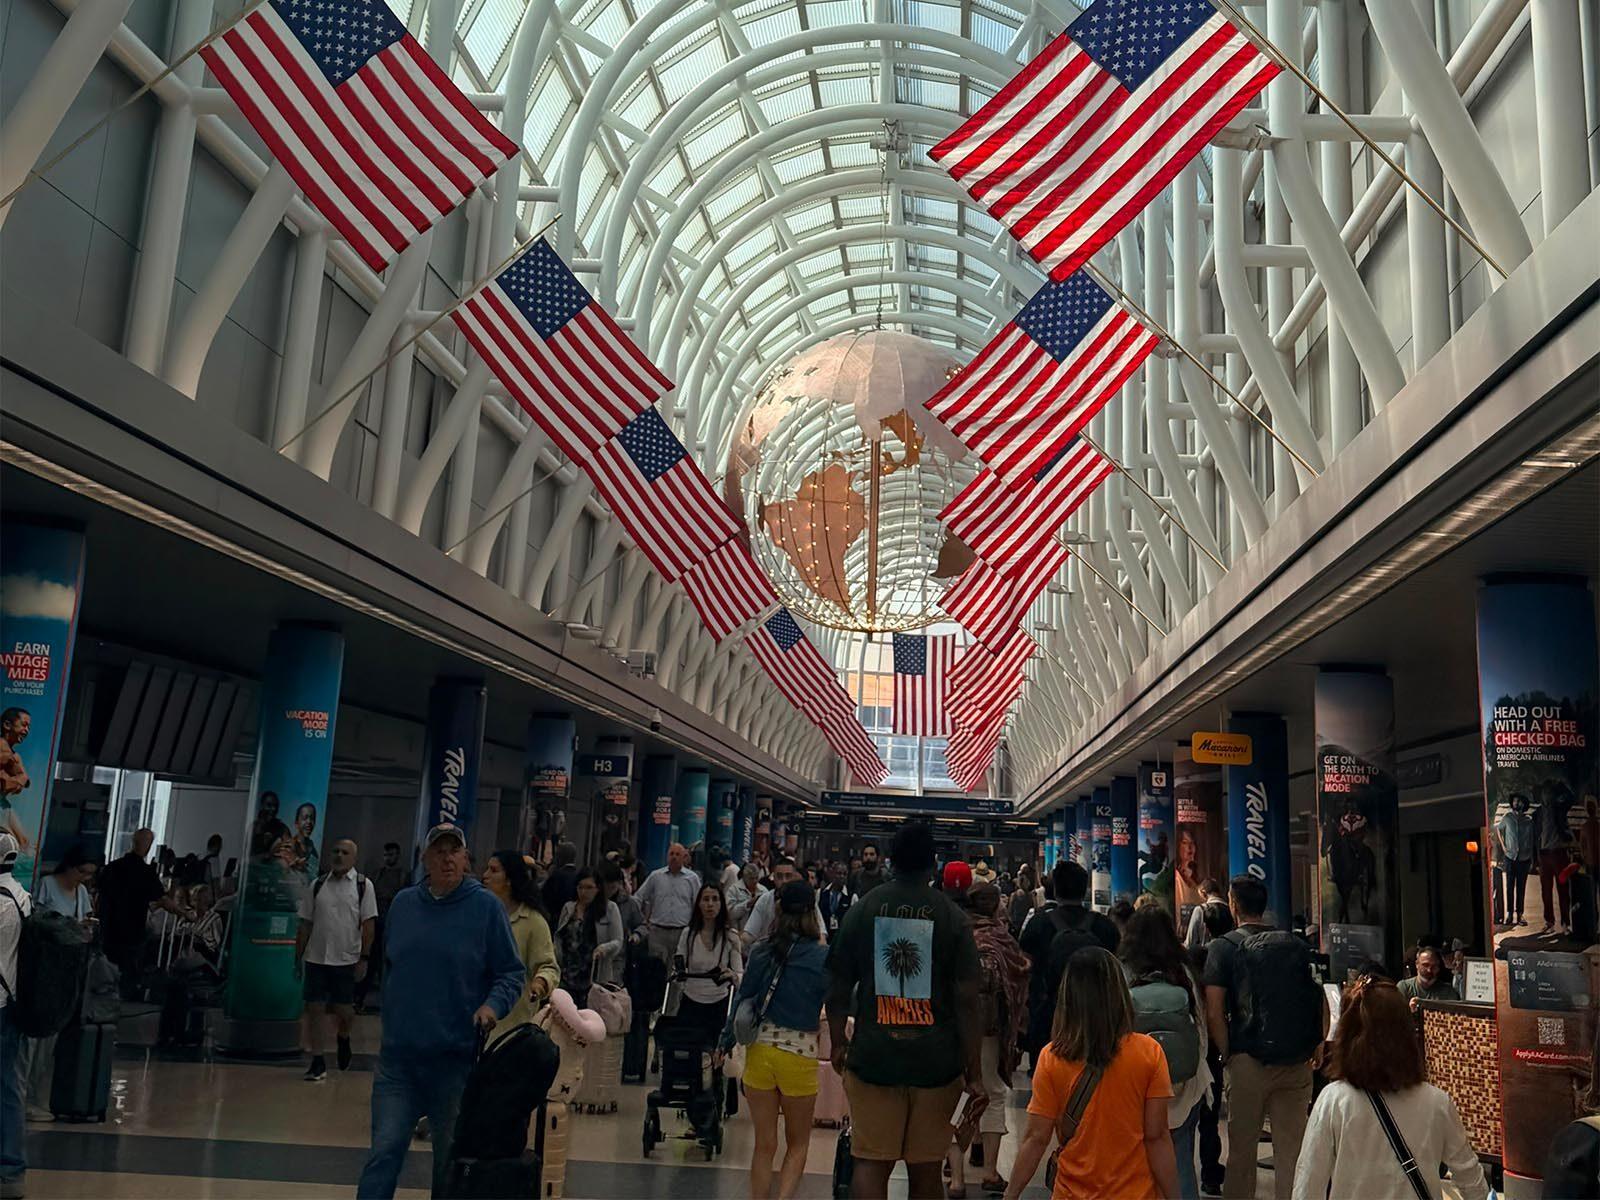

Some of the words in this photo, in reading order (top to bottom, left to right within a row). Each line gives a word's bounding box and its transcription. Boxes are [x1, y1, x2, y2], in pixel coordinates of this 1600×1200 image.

[15, 641, 50, 656] EARN
[8, 667, 47, 681] MILES
[285, 710, 329, 721] VACATION
[1494, 706, 1528, 719] HEAD
[1531, 706, 1562, 719] OUT
[302, 719, 328, 729] MODE
[1494, 719, 1526, 732] WITH
[1529, 719, 1542, 732] A
[1544, 720, 1577, 733] FREE
[304, 729, 313, 738] IS
[314, 729, 327, 739] ON
[1495, 732, 1555, 746] CHECKED
[1559, 733, 1586, 748] BAG
[1198, 739, 1248, 753] Macaroni
[1496, 746, 1505, 754] ON
[1506, 746, 1542, 754] DOMESTIC
[1323, 755, 1339, 765] GET
[1340, 755, 1356, 765] ON
[1532, 754, 1565, 762] AIRLINES
[593, 759, 613, 773] H3
[1323, 764, 1339, 773] THE
[1340, 765, 1365, 775] PATH
[1366, 766, 1380, 776] TO
[440, 747, 465, 822] TRAVEL
[1324, 773, 1370, 784] VACATION
[1324, 783, 1351, 792] MODE
[1096, 805, 1112, 816] K2
[1245, 782, 1268, 859] TRAVEL
[876, 995, 935, 1026] ANGELES
